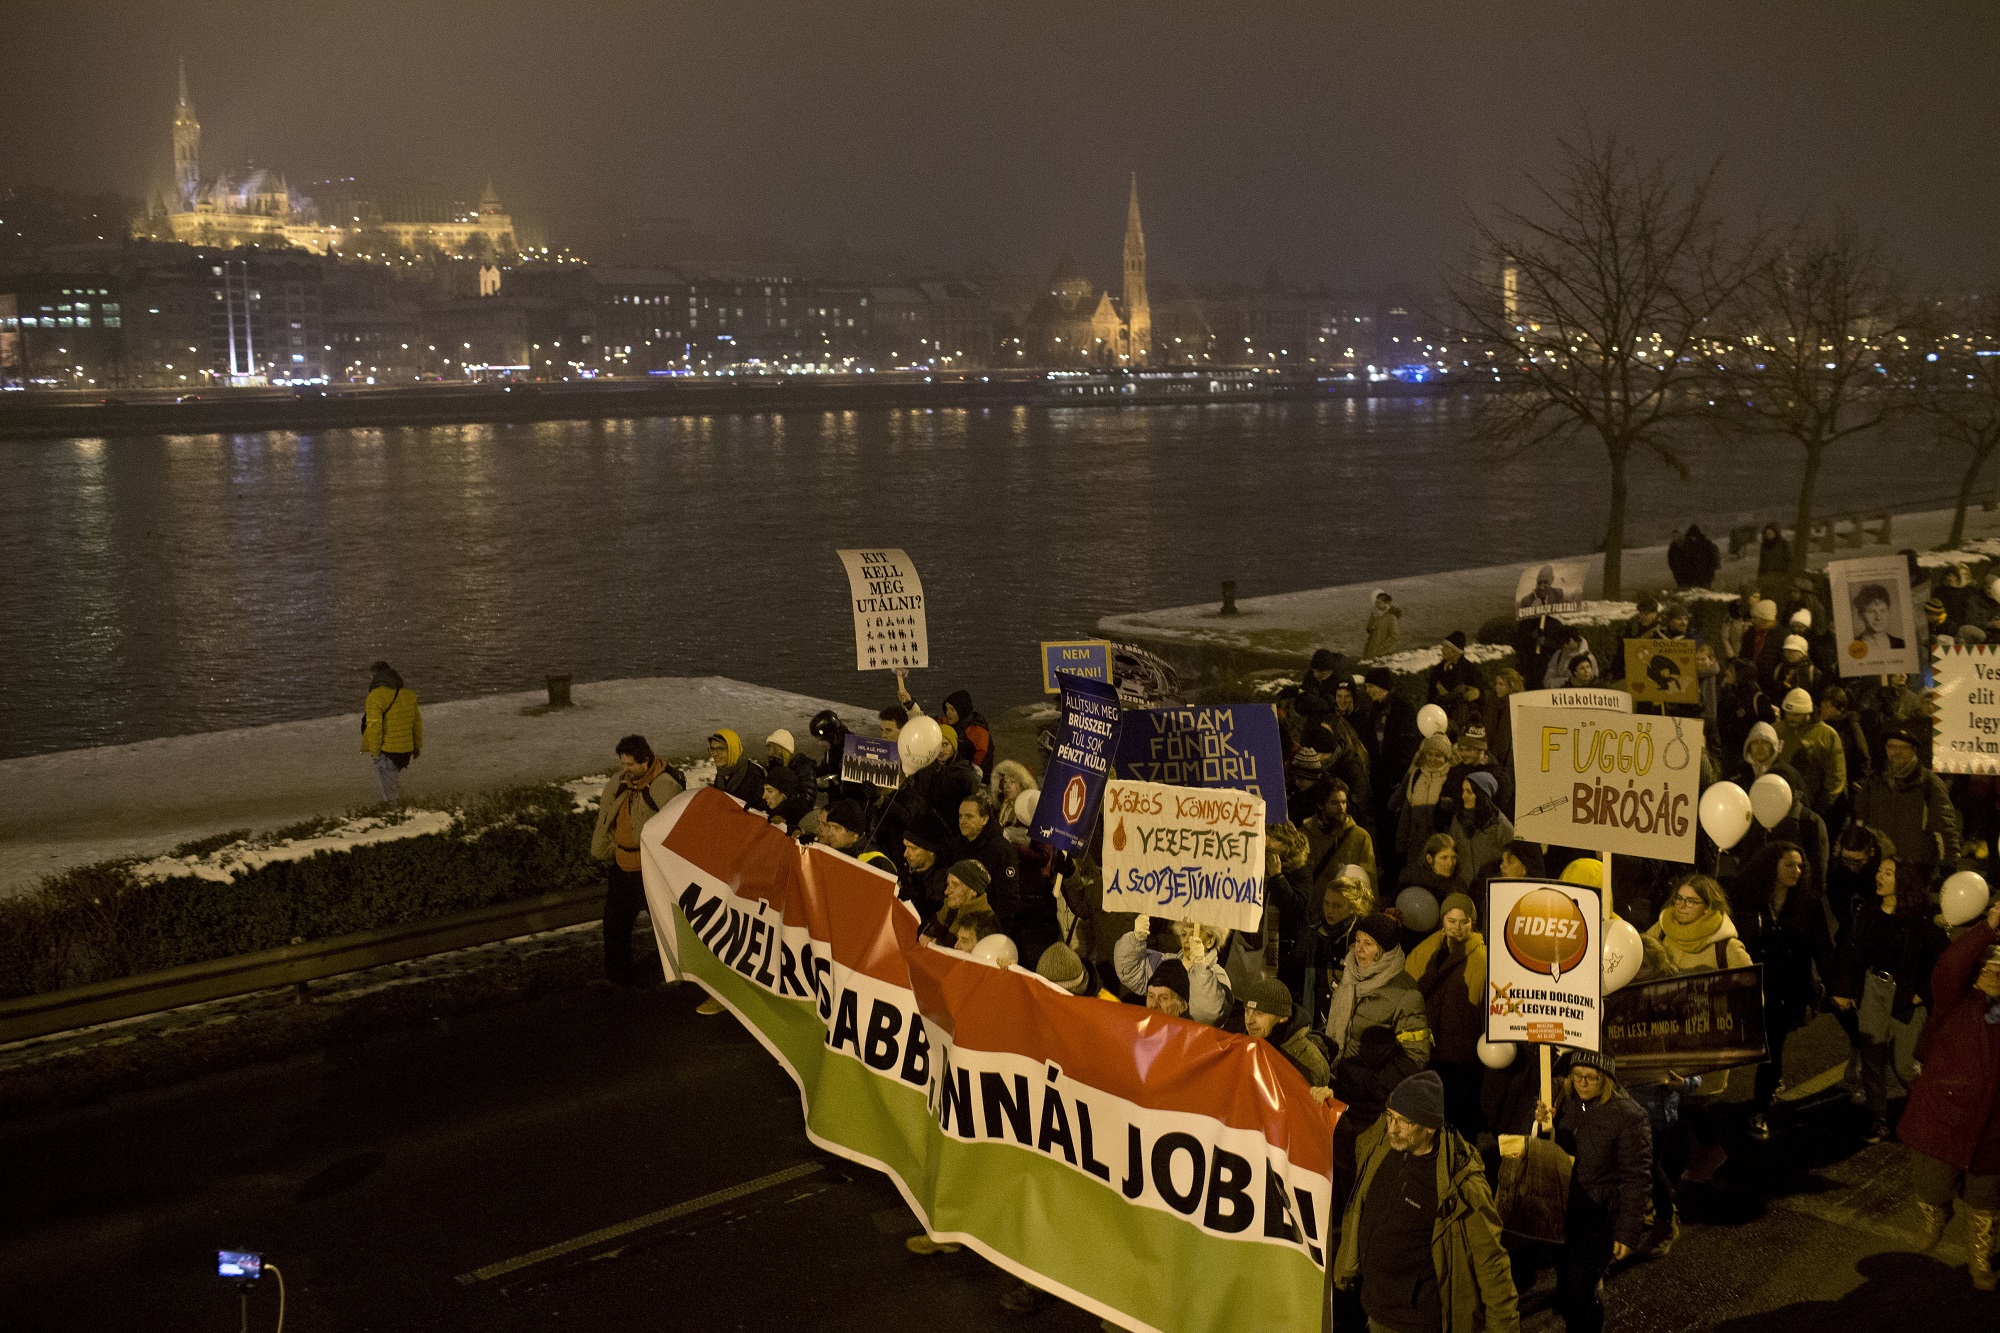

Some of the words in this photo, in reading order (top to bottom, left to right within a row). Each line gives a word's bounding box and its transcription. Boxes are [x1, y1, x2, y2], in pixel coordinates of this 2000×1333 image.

[860, 552, 889, 564] KIT
[860, 565, 904, 579] KELL
[868, 577, 904, 595] MÉG
[856, 594, 922, 613] UTÁLNI?
[1062, 649, 1091, 660] NEM
[1065, 692, 1100, 716] ÁLLÍTSUK
[1101, 704, 1119, 721] MEG
[1551, 693, 1620, 708] kilakoltatott
[1968, 688, 1995, 704] elit
[1068, 712, 1113, 739] BRÜSSZELT,
[1150, 708, 1235, 734] VIDÁM
[1969, 712, 2000, 734] legy
[1072, 730, 1085, 748] TÚL
[1086, 736, 1104, 753] SOK
[1057, 742, 1085, 764] PÉNZT
[1083, 752, 1107, 773] KÜLD.
[1109, 787, 1163, 815] KÖZÖS
[1572, 776, 1689, 837] BÍRÓSÁG
[1137, 825, 1259, 864] VEZETÉKET
[1106, 868, 1123, 895] A
[1513, 916, 1581, 940] FIDESZ
[1509, 988, 1547, 1001] KELLJEN
[1549, 991, 1595, 1010] DOLGOZNI,
[1522, 1003, 1557, 1016] LEGYEN
[1559, 1006, 1584, 1021] PÉNZ!
[1651, 1019, 1680, 1036] MINDIG
[678, 881, 776, 989] MINÉL
[1122, 1122, 1325, 1268] JOBB!
